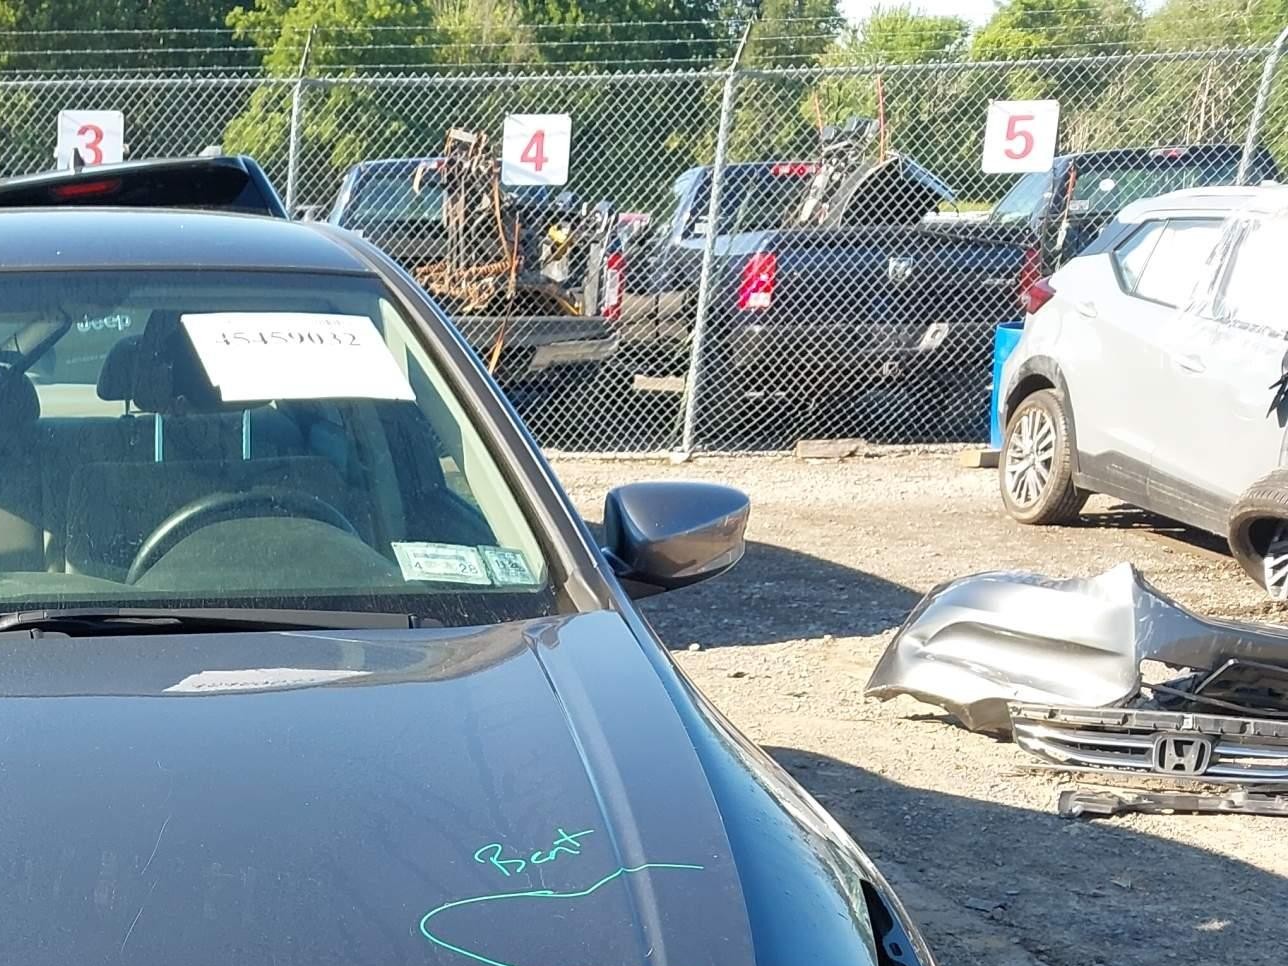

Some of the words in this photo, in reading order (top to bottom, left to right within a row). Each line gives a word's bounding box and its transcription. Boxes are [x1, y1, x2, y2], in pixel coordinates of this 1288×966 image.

[77, 124, 104, 165] 3
[519, 129, 549, 172] 4
[1004, 115, 1035, 160] 5
